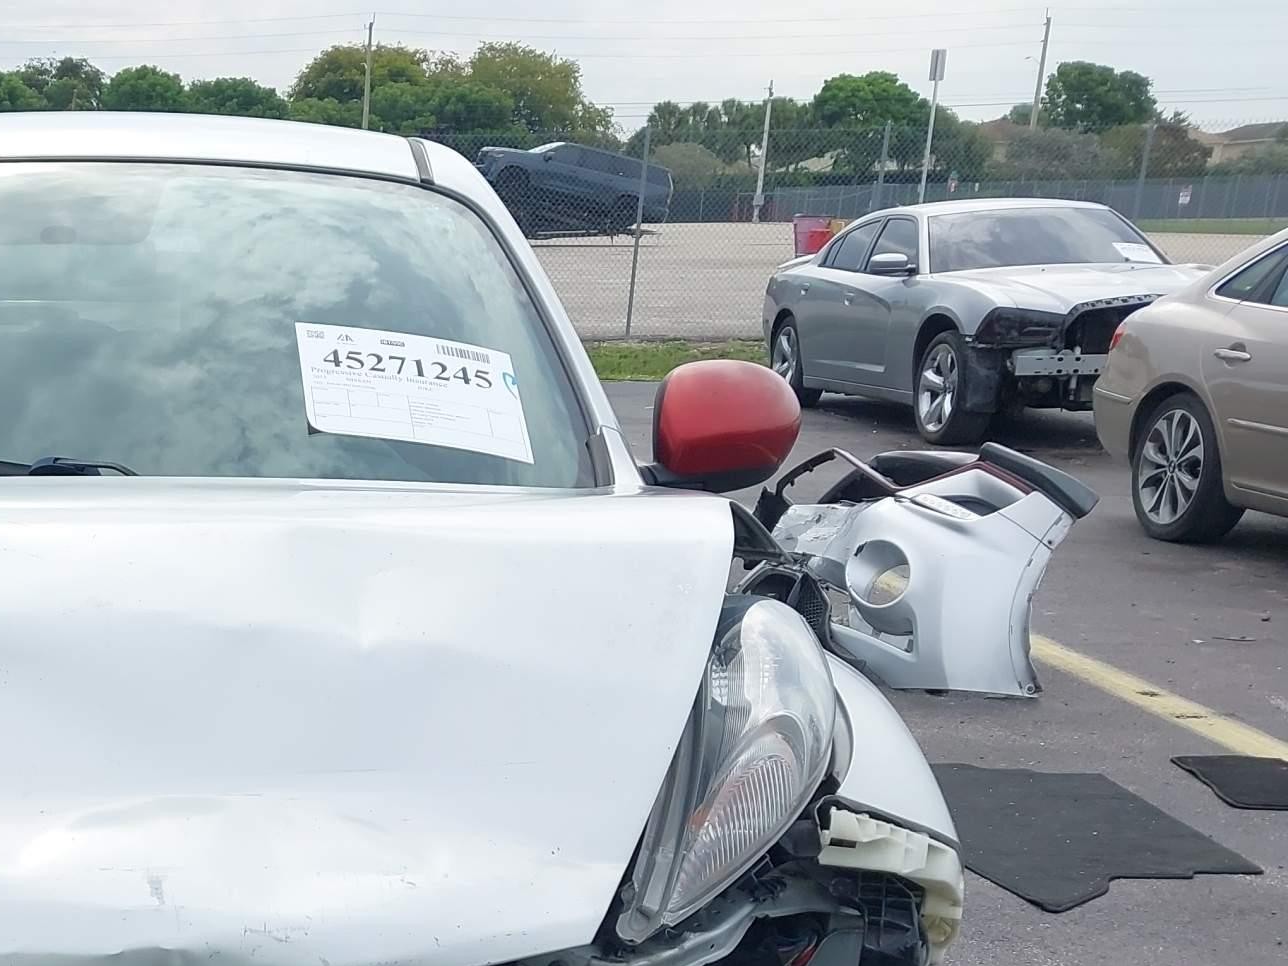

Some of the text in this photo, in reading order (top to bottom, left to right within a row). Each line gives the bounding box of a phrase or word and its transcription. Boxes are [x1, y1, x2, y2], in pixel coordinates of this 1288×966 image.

[311, 366, 363, 377] Progressive
[406, 376, 448, 389] Insurance
[322, 348, 493, 389] 45271245
